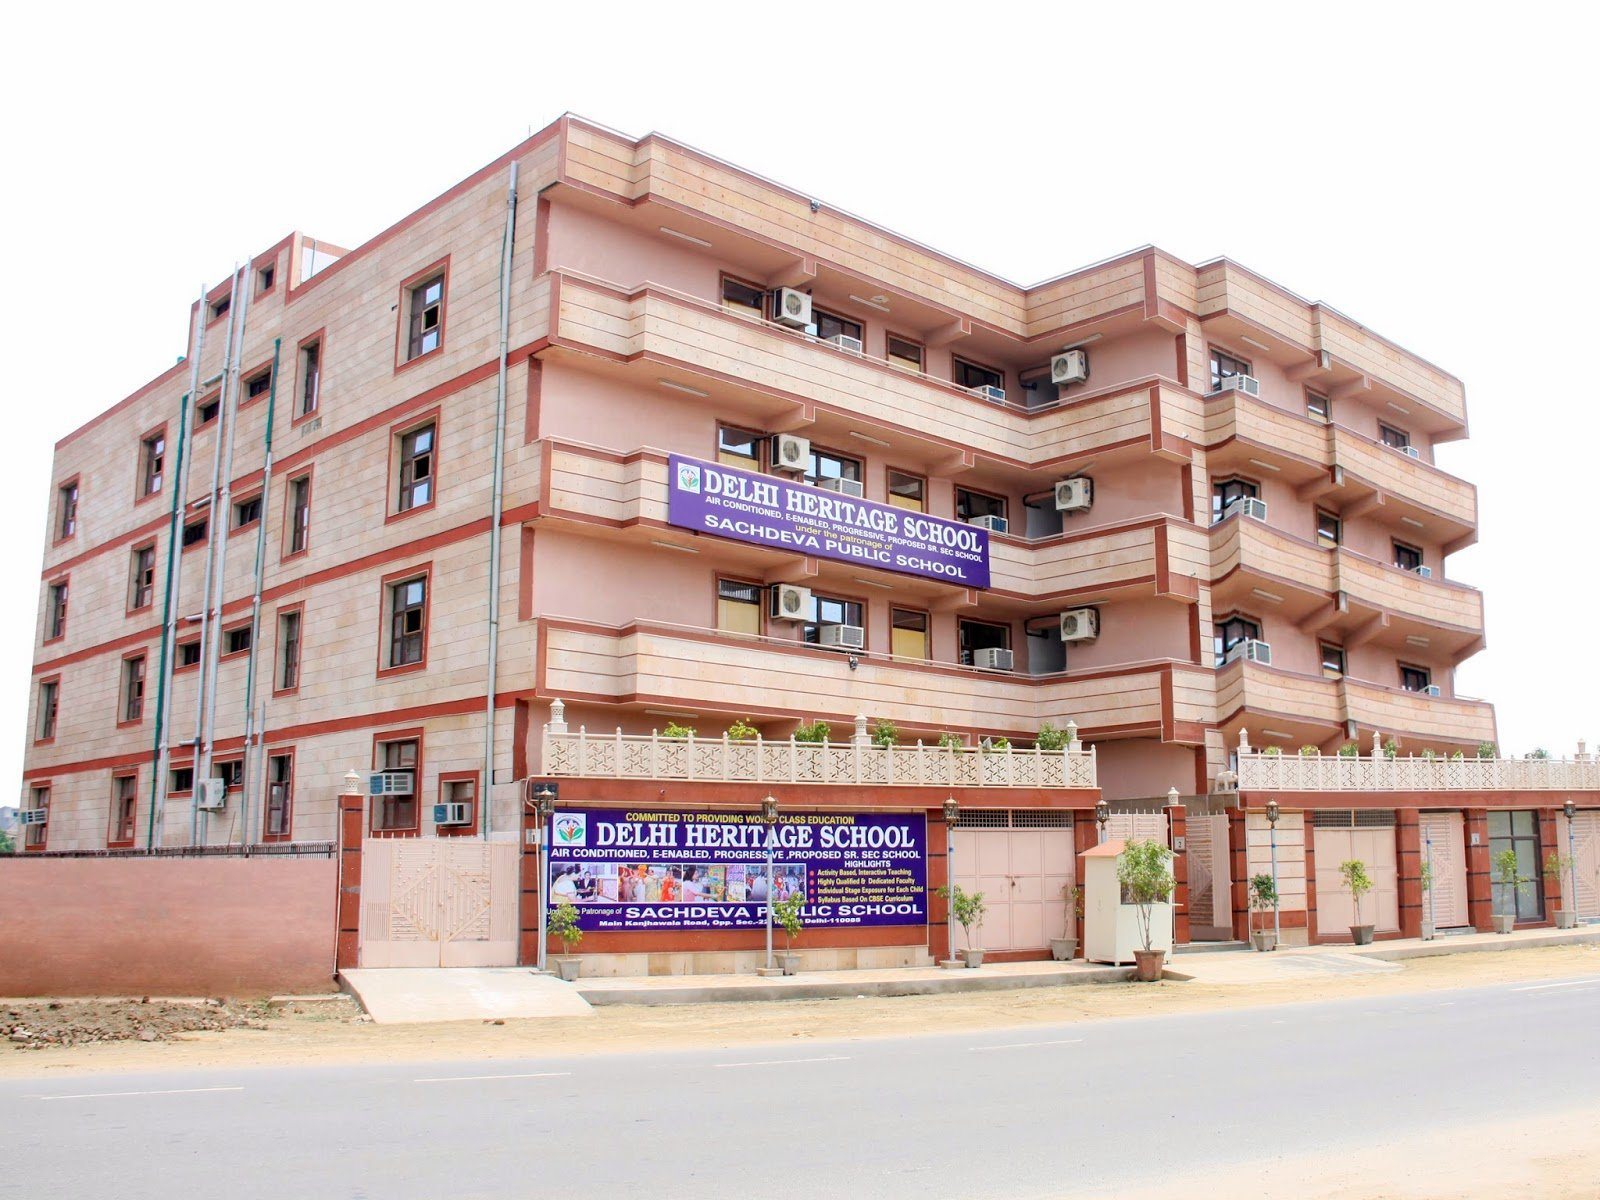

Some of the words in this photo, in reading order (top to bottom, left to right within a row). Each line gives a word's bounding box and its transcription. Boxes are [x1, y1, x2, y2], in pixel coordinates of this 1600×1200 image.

[703, 468, 779, 508] DELHI
[785, 488, 899, 535] HERITAGE
[903, 516, 983, 554] SCHOOL
[705, 495, 721, 506] AIR
[722, 499, 784, 520] CONDITIONED,
[785, 513, 831, 530] E-ENABLED,
[832, 523, 887, 542] PROGRESSIVE,
[888, 535, 926, 550] PROPOSED
[927, 544, 939, 553] SR.
[940, 547, 954, 556] SEC
[954, 548, 983, 563] SCHOOL
[795, 524, 821, 536] under
[823, 529, 838, 539] the
[840, 534, 882, 550] patronage
[884, 542, 893, 551] of
[704, 514, 820, 549] SACHDEVA
[825, 539, 891, 563] PUBLIC
[896, 554, 967, 579] SCHOOL
[625, 812, 680, 823] COMMITTED
[682, 813, 695, 823] TO
[696, 814, 743, 824] PROVIDING
[778, 815, 806, 825] CLASS
[808, 816, 855, 825] EDUCATION
[596, 822, 678, 847] DELHI
[685, 824, 813, 848] HERITAGE
[820, 825, 915, 848] SCHOOL
[550, 848, 570, 858] AIR
[572, 849, 650, 860] CONDITIONED,
[653, 849, 711, 860] E-ENABLED,
[714, 850, 784, 860] PROGRESSVE
[843, 850, 860, 860] SR.
[861, 850, 880, 860] SEC
[882, 850, 921, 860] SCHOOL
[844, 860, 891, 868] HIGHLIGHTS
[817, 869, 838, 877] Activity
[858, 868, 887, 876] Interactive
[888, 868, 912, 877] Teaching
[817, 878, 834, 886] Highly
[868, 877, 895, 885] Dedicated
[895, 877, 915, 885] Faculty
[844, 887, 860, 895] Stage
[861, 887, 887, 895] Exposure
[817, 896, 841, 904] Syllabus
[581, 908, 615, 917] Patronage
[615, 907, 623, 915] of
[625, 906, 750, 919] SACHDEVA
[838, 903, 923, 916] SCHOOL
[624, 919, 682, 928] Kanjhawala
[683, 919, 710, 927] Road,
[712, 919, 734, 927] Opp.
